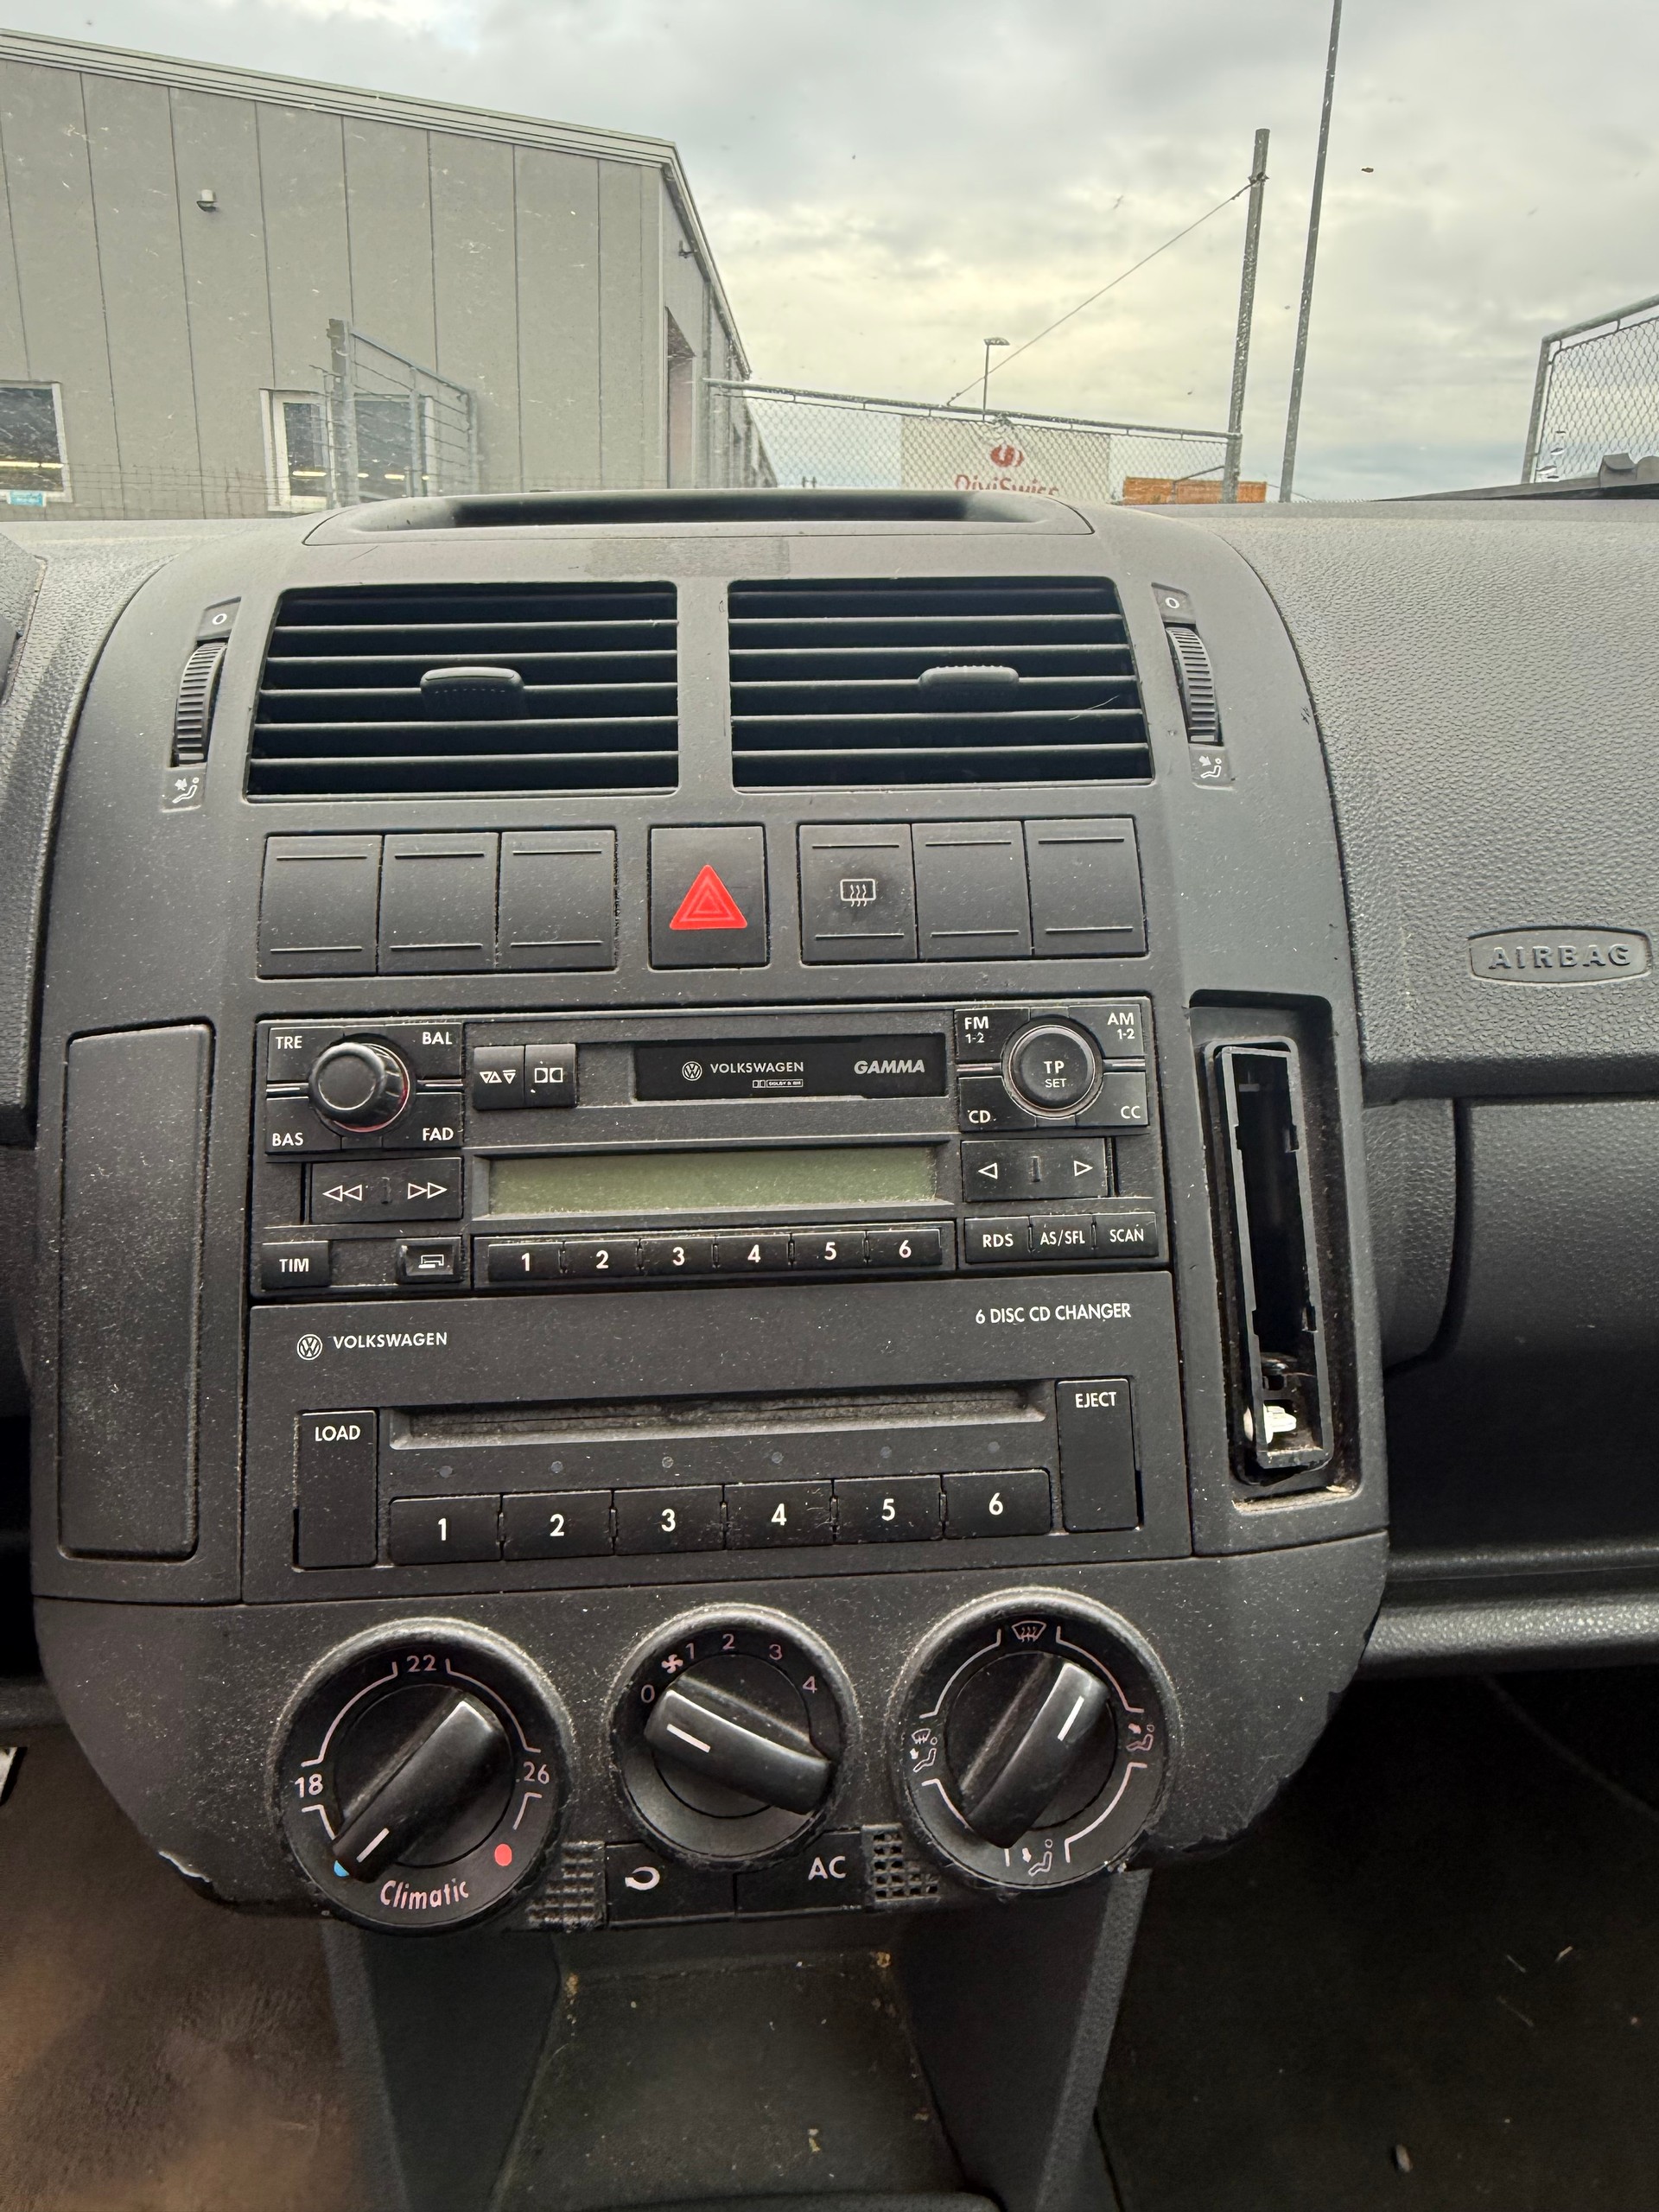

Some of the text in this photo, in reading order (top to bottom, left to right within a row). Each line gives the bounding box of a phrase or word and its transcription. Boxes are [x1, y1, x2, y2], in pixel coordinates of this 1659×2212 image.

[1488, 944, 1631, 969] AIRBAG
[965, 1016, 988, 1029] FM
[1108, 1013, 1134, 1025] AM
[423, 1032, 452, 1045] BAL
[965, 1032, 984, 1043] 1-2
[1117, 1028, 1135, 1039] 1-2
[276, 1036, 302, 1049] TRE
[710, 1062, 804, 1073] VOLKSWAGEN
[855, 1059, 925, 1074] GAMMA
[1044, 1061, 1064, 1073] TP
[1045, 1078, 1066, 1088] SET
[969, 1110, 990, 1123] CD
[1121, 1105, 1141, 1119] CC
[272, 1133, 303, 1146] BAS
[423, 1128, 454, 1141] FAD
[983, 1234, 1014, 1247] RDS
[1040, 1230, 1085, 1246] AS/SFL
[1110, 1229, 1143, 1242] SCAN
[673, 1247, 684, 1266] 3
[747, 1244, 760, 1262] 4
[824, 1242, 836, 1260] 5
[899, 1240, 912, 1258] 6
[279, 1258, 308, 1272] TIM
[522, 1253, 530, 1271] 1
[596, 1250, 608, 1268] 2
[976, 1303, 1131, 1324] 6 DISC CD CHANGER
[334, 1332, 447, 1349] VOLKSWAGEN
[1076, 1392, 1116, 1408] EJECT
[315, 1426, 360, 1441] LOAD
[882, 1498, 895, 1521] 5
[989, 1493, 1003, 1515] 6
[662, 1509, 676, 1531] 3
[772, 1503, 786, 1525] 4
[438, 1518, 446, 1541] 1
[550, 1514, 564, 1536] 2
[723, 1634, 734, 1649] 2
[686, 1643, 694, 1659] 1
[770, 1644, 782, 1660] 3
[407, 1655, 436, 1672] 22
[803, 1676, 817, 1694] 4
[524, 1762, 550, 1784] 26
[295, 1774, 323, 1797] 18
[809, 1856, 846, 1880] AC
[381, 1878, 468, 1909] Climatic
